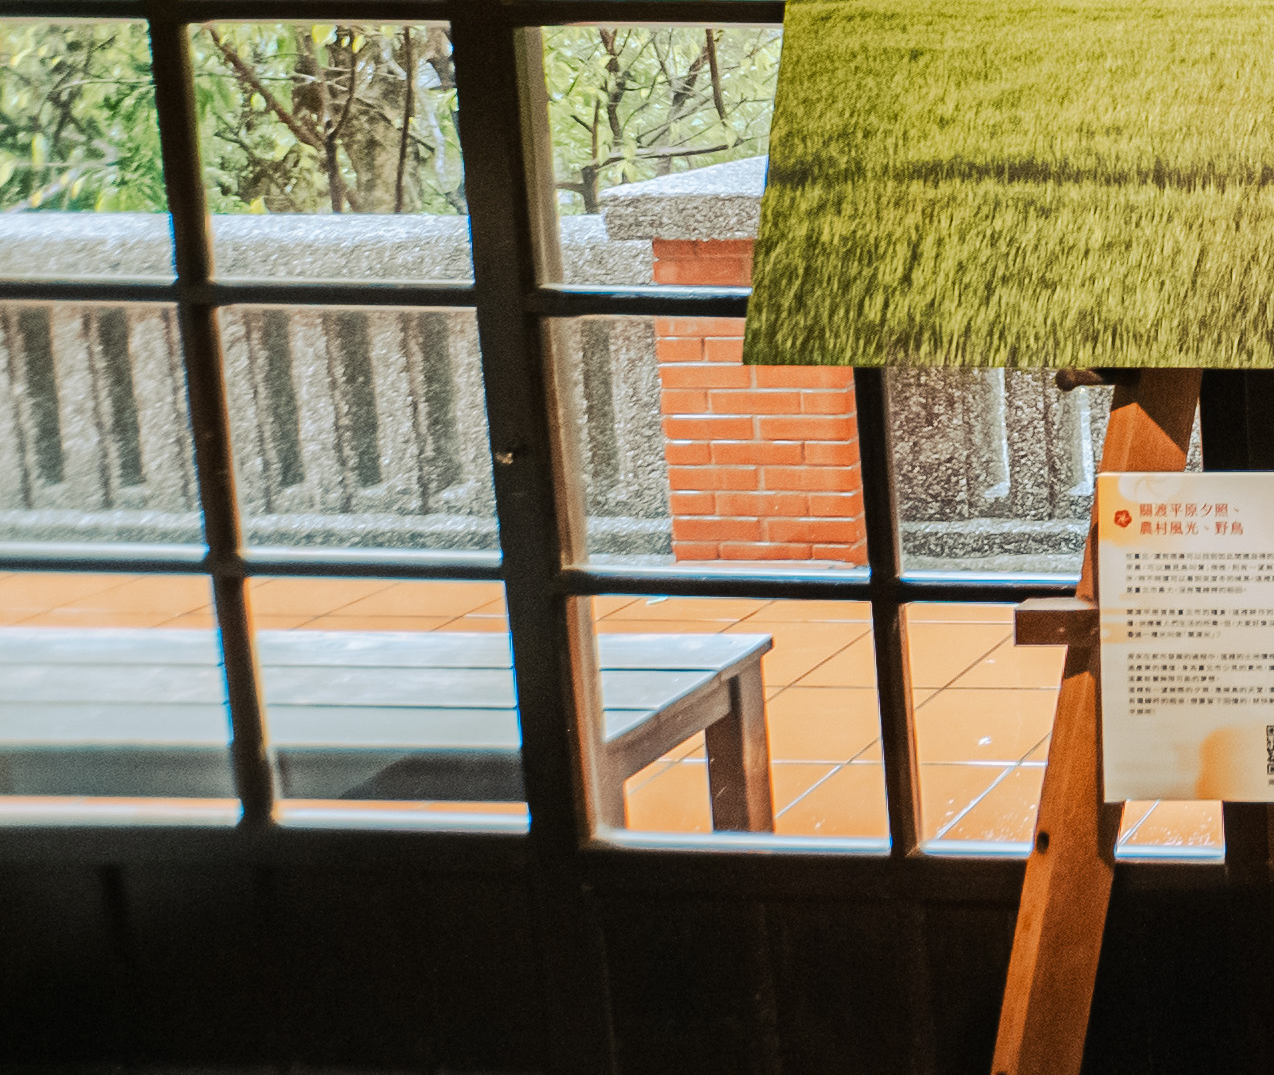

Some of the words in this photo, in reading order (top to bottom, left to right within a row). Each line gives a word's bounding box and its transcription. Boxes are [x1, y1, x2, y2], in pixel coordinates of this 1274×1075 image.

[1139, 520, 1245, 535] 農村風光、野鳥
